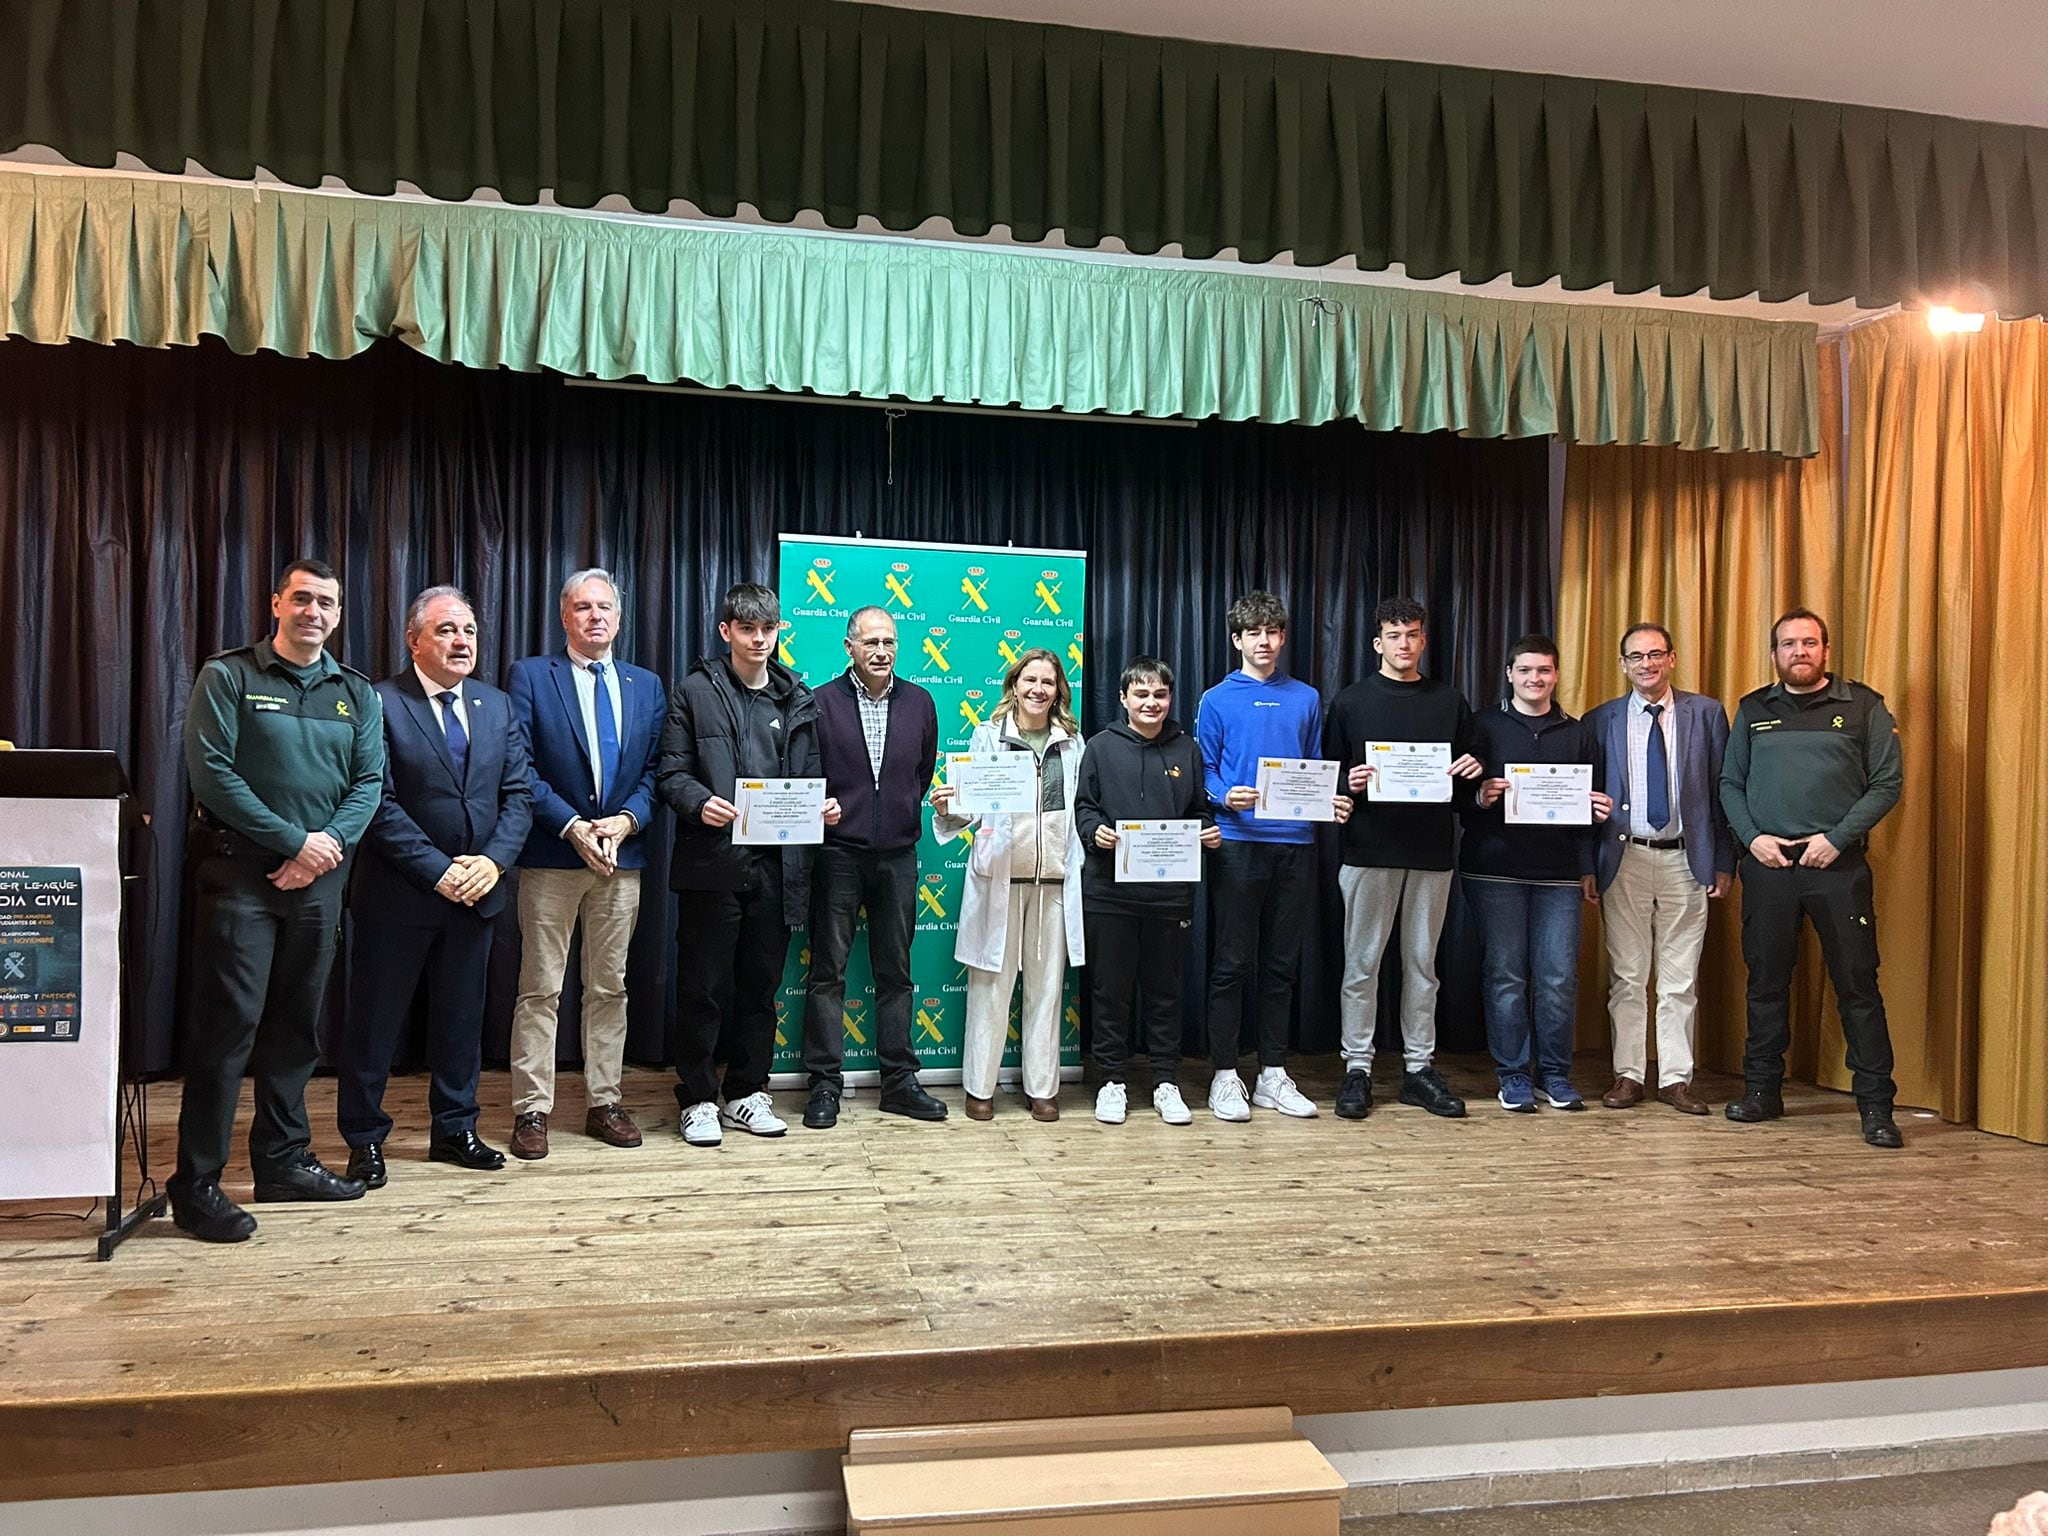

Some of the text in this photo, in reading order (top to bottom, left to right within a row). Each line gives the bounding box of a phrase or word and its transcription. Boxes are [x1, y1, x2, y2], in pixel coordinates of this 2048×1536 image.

[793, 606, 849, 618] Guardia Civil
[906, 612, 926, 621] Civil
[948, 614, 1001, 624] Guardia Civil
[1023, 617, 1073, 627] Guardia Civil
[910, 674, 963, 685] Guardia Civil
[0, 879, 78, 892] ER LEAGUE
[0, 895, 78, 906] DIA CIVIL
[785, 986, 807, 995] Guar
[942, 984, 968, 993] Guard
[860, 1048, 877, 1057] Civi
[937, 1046, 957, 1055] Civil
